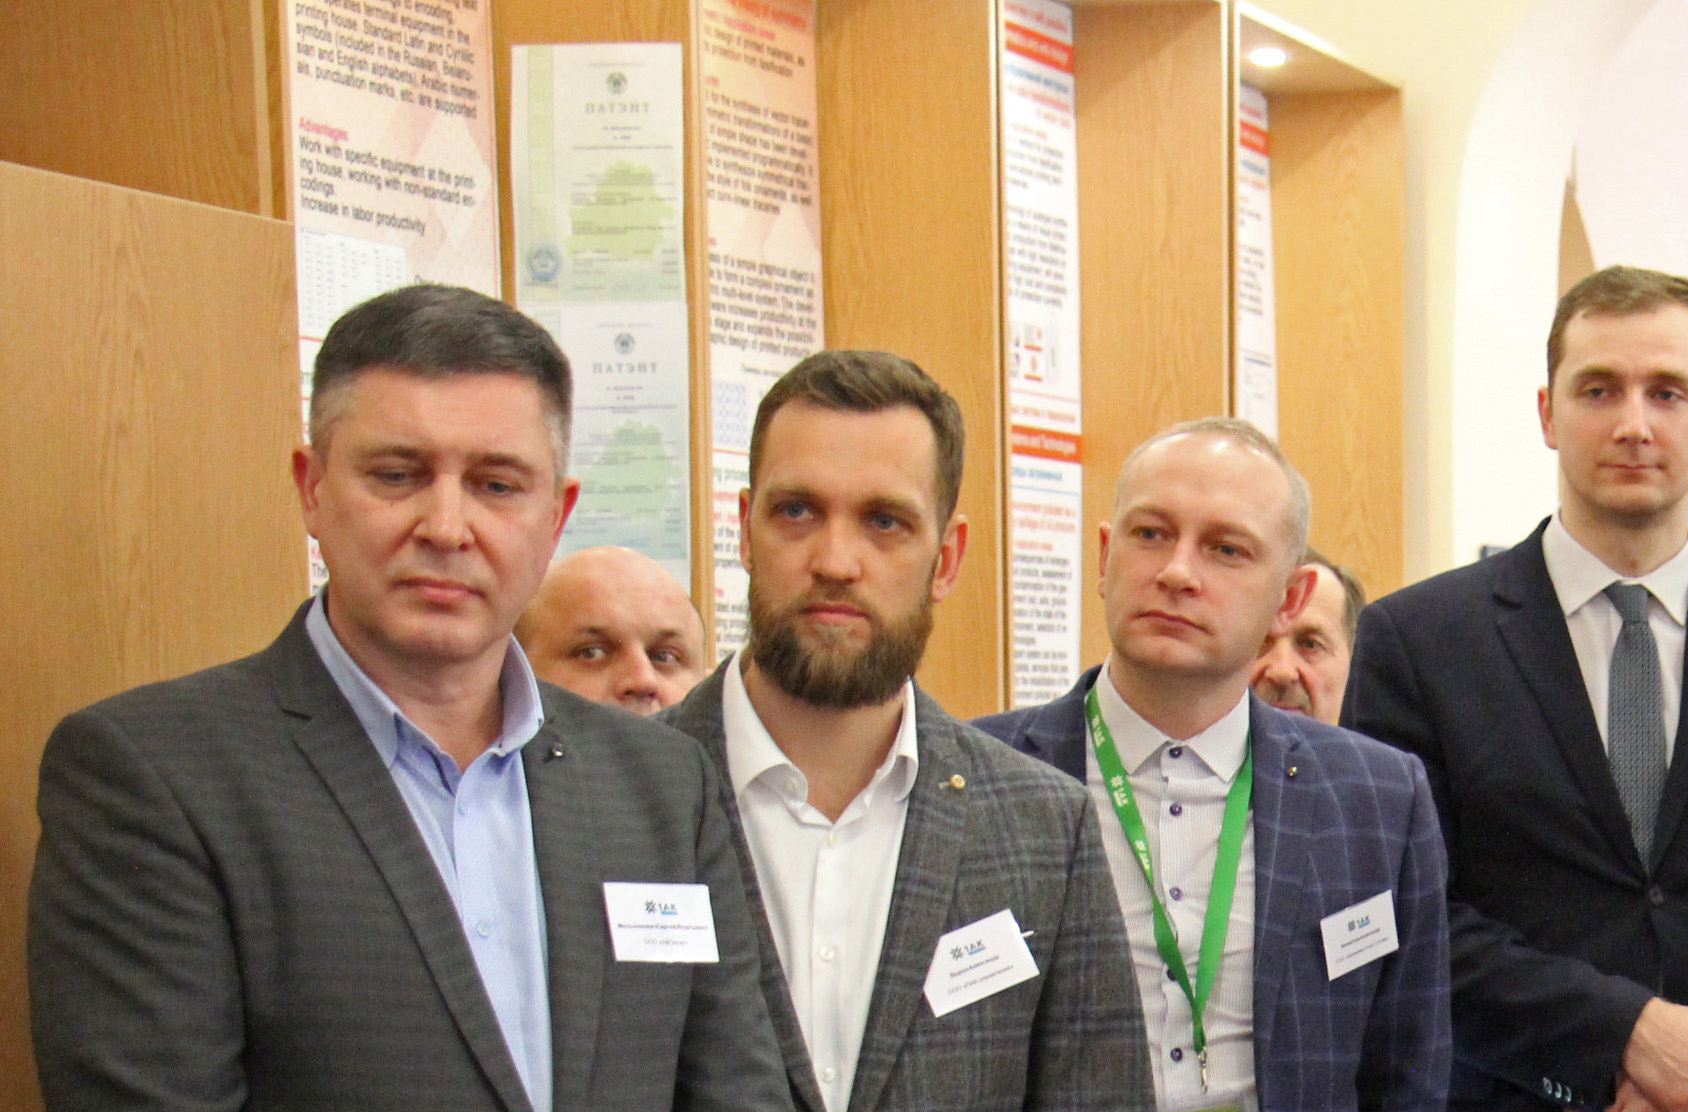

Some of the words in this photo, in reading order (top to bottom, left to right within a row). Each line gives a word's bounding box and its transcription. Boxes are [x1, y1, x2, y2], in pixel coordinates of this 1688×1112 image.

[296, 4, 328, 26] printing
[363, 19, 401, 42] Standard
[404, 33, 424, 50] Latin
[428, 41, 443, 55] and
[296, 23, 332, 43] symbols
[388, 47, 400, 62] the
[457, 29, 470, 45] the
[315, 66, 366, 89] punctuation
[419, 94, 432, 108] are
[435, 98, 477, 118] supported
[318, 48, 334, 62] and
[337, 51, 368, 72] English
[422, 74, 448, 94] Arabic
[300, 135, 321, 151] Work
[325, 145, 342, 158] with
[345, 149, 377, 168] specific
[381, 157, 425, 178] equipment
[428, 168, 435, 181] at
[438, 169, 450, 183] the
[300, 157, 313, 174] ing
[348, 169, 381, 190] working
[385, 177, 400, 190] with
[301, 194, 338, 215] Increase
[342, 201, 349, 216] in
[352, 205, 374, 221] labor
[377, 211, 426, 236] productivity
